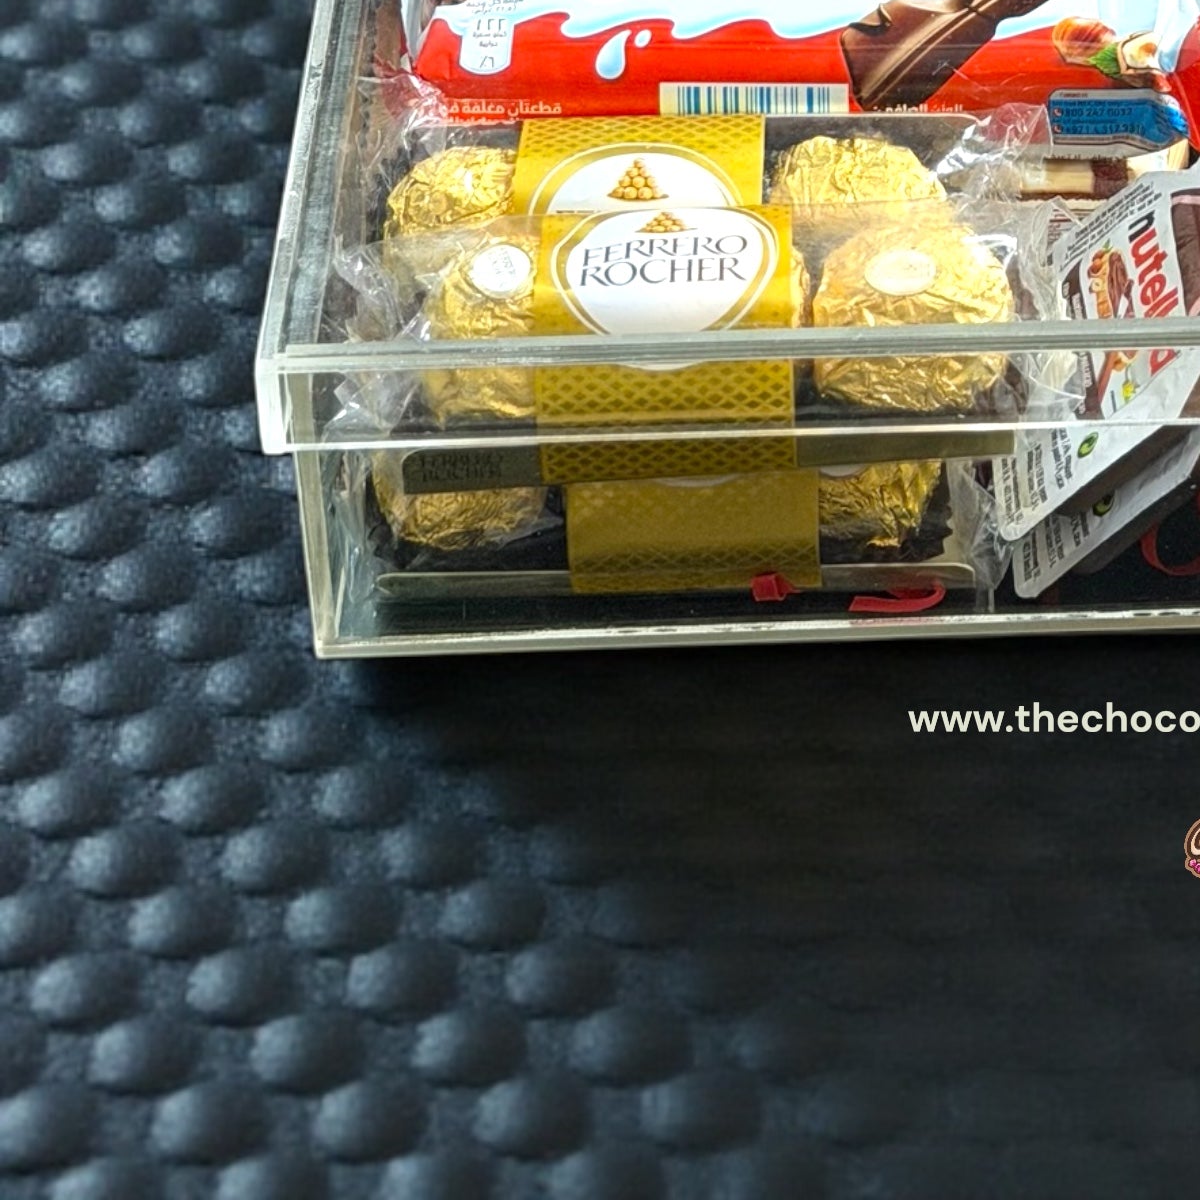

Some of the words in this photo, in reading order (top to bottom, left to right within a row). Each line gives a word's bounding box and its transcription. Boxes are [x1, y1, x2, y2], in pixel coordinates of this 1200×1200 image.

[507, 100, 562, 117] قطعتان
[581, 234, 749, 268] FERRERO
[578, 256, 748, 287] ROCHER
